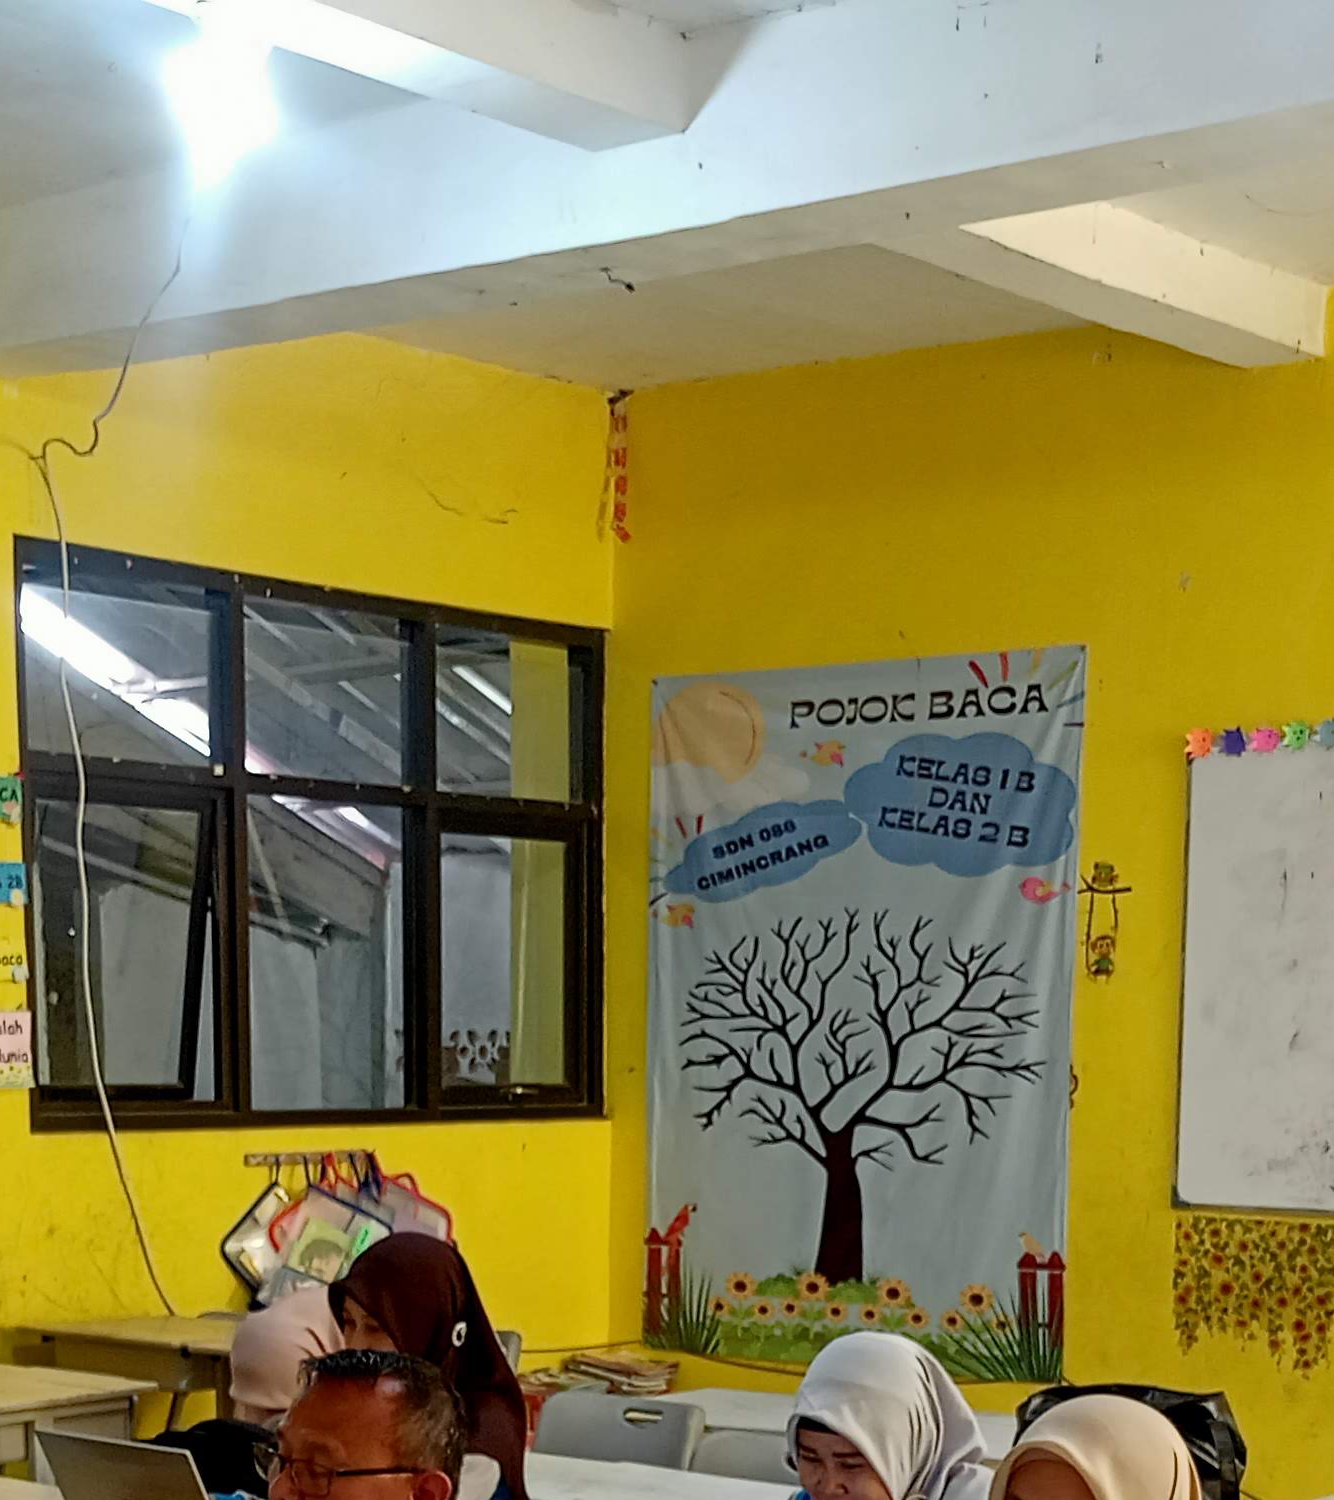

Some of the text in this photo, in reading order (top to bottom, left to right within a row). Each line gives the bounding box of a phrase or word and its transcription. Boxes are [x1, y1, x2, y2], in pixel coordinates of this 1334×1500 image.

[789, 683, 1049, 729] POJOK BACA
[896, 754, 991, 786] KELAS
[927, 786, 992, 815] DAN
[877, 806, 973, 839] KELAS
[712, 833, 755, 859] SDN
